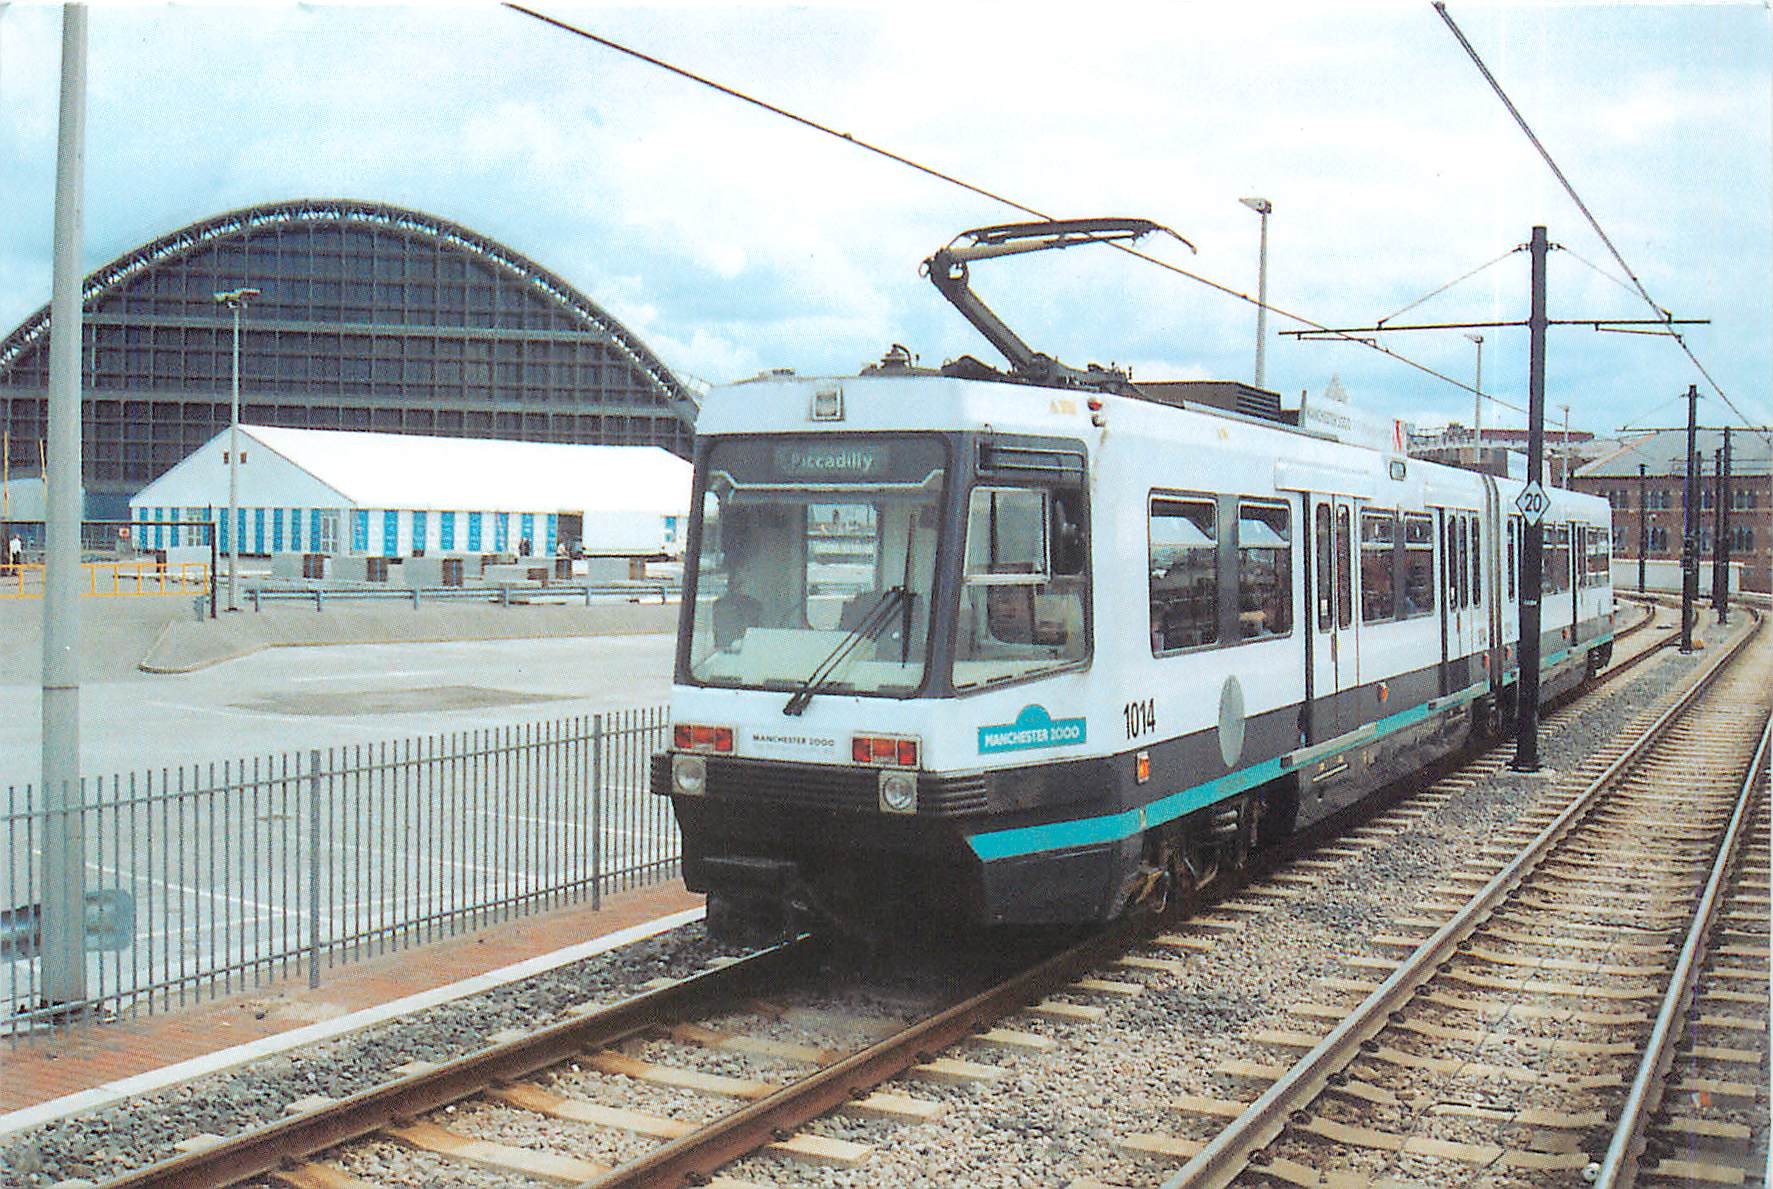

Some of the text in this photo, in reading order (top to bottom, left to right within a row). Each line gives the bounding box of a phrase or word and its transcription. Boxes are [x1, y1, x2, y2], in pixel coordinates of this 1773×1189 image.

[791, 448, 873, 473] Piccadilly
[1524, 492, 1542, 513] 20
[1123, 697, 1156, 741] 1014
[752, 733, 835, 747] MANCHESTER 2000
[983, 725, 1080, 748] MANCHESTER 2000
